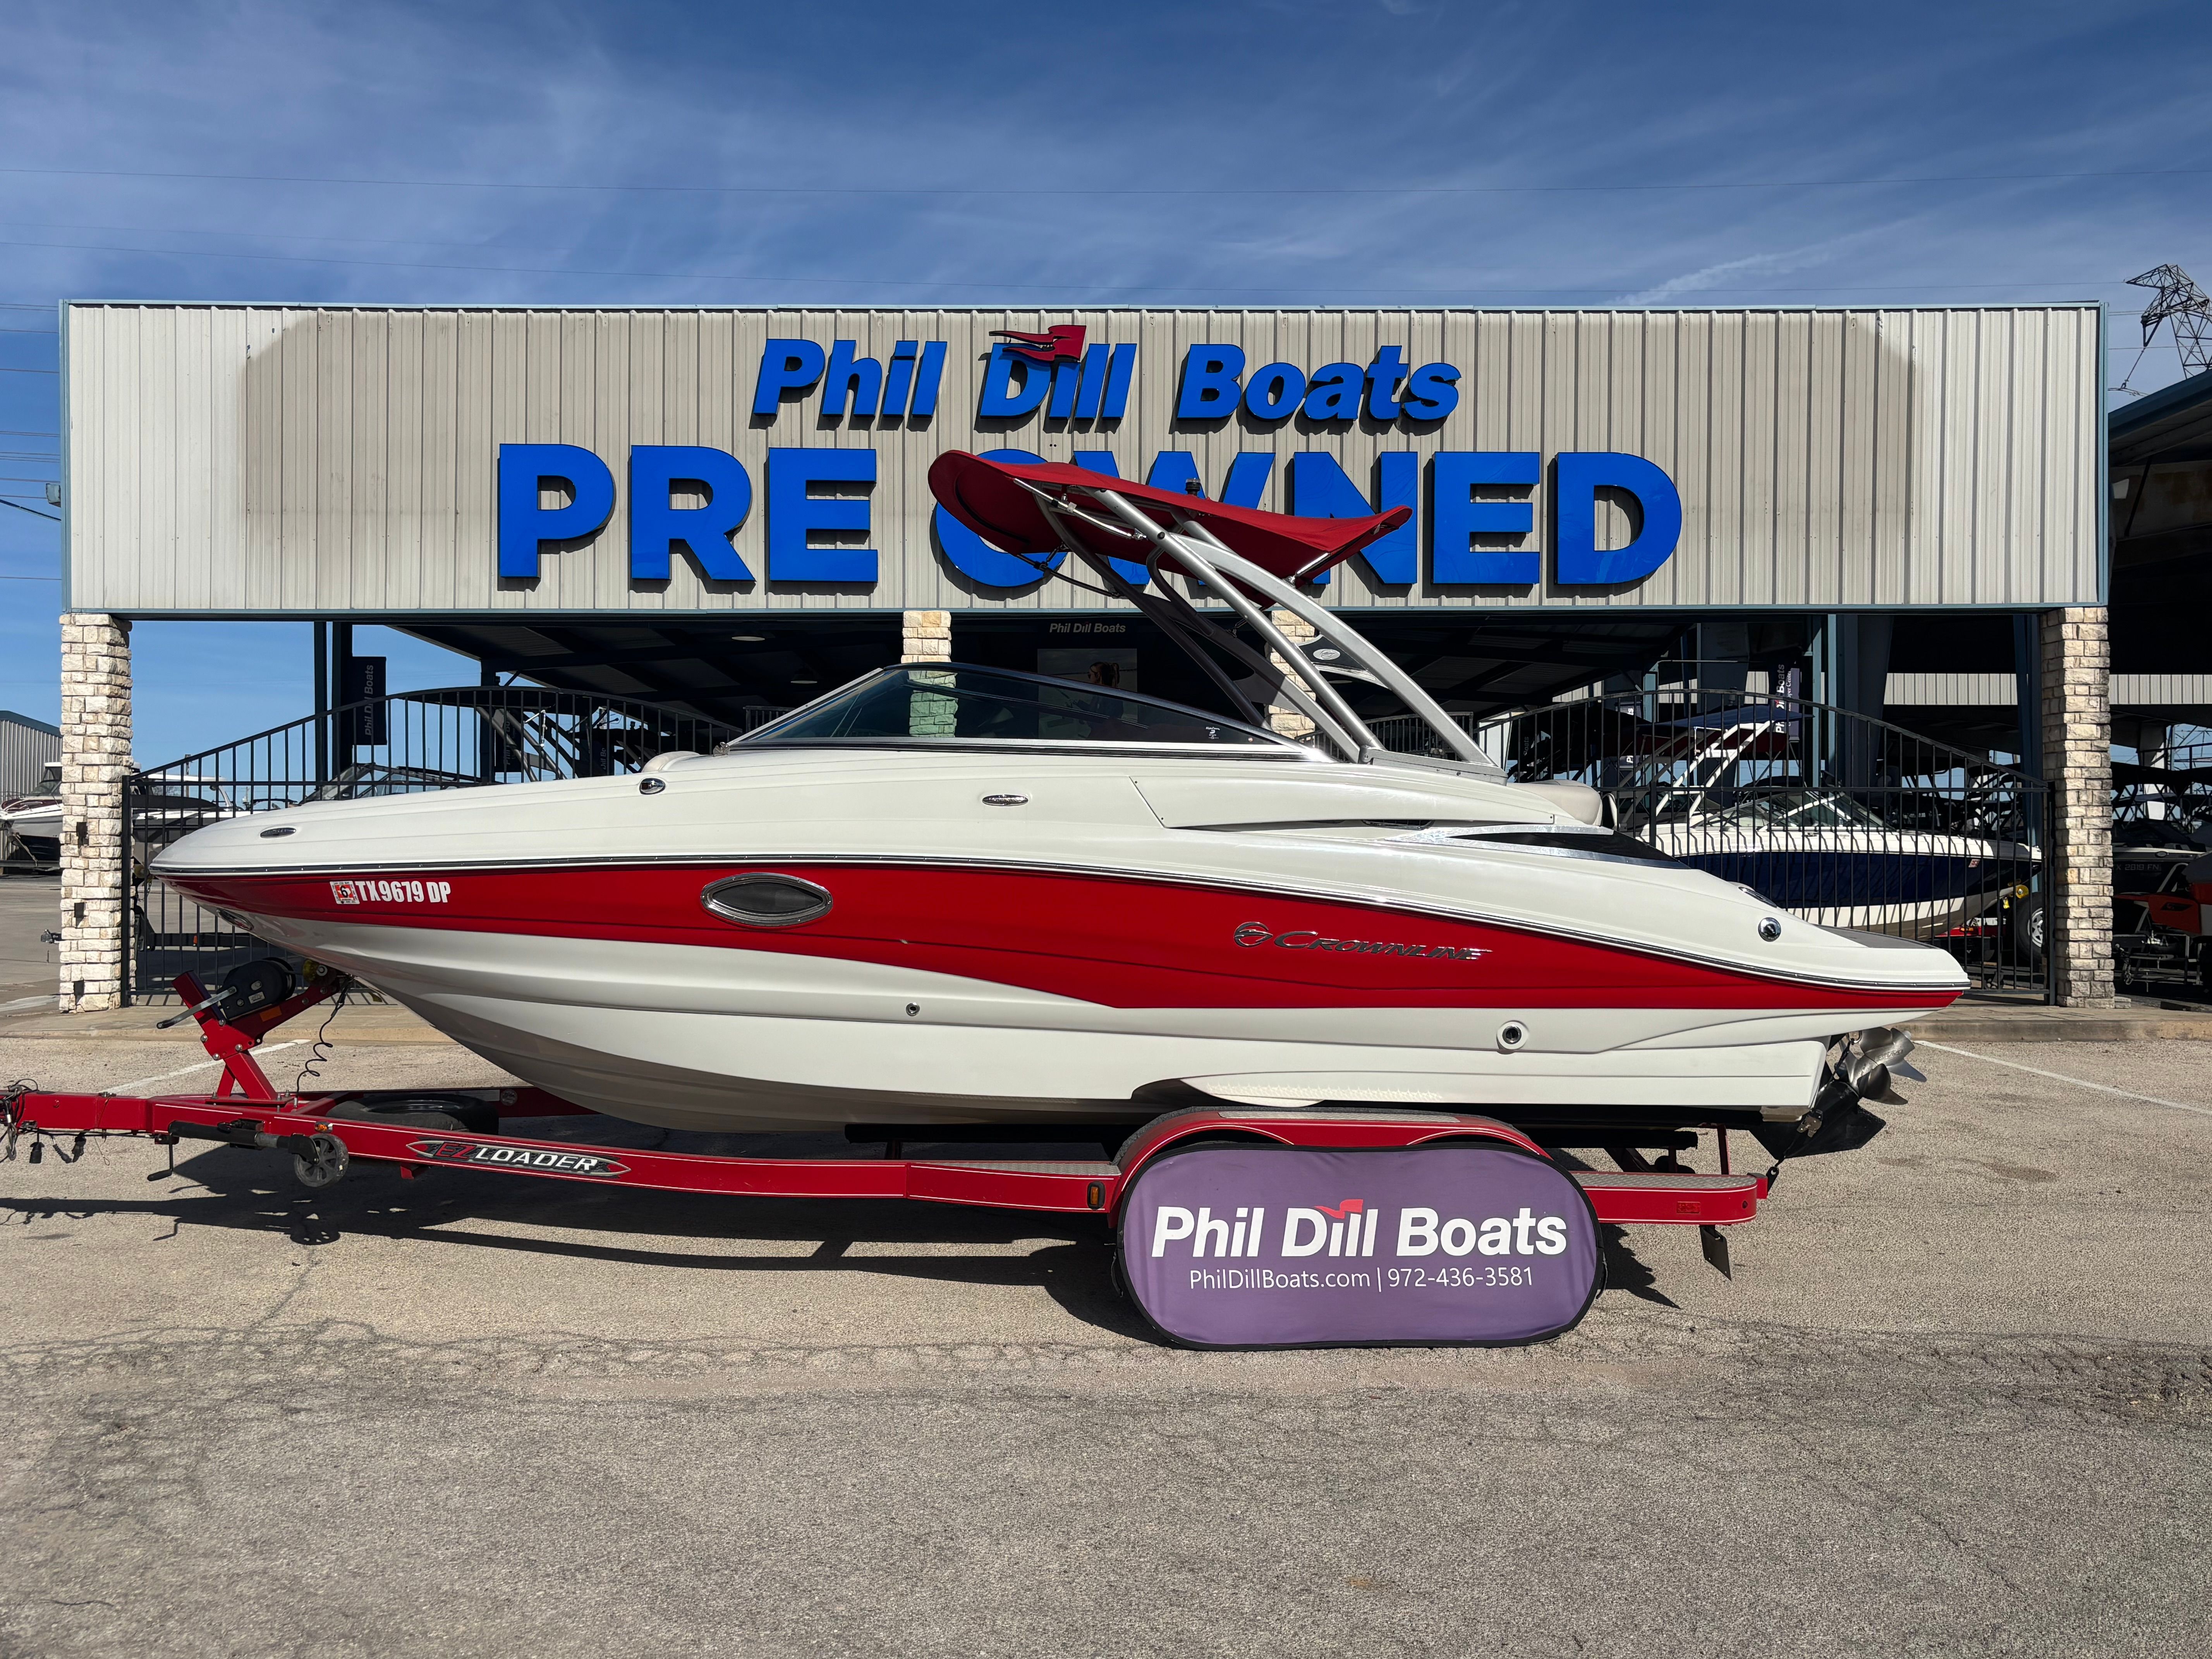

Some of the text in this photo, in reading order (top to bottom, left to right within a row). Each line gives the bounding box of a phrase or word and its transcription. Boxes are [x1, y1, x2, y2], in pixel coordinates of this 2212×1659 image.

[753, 339, 1461, 420] Phil Dill Boats
[499, 444, 878, 582] PRE
[1049, 623, 1126, 632] Phil Dill Boats
[364, 665, 373, 695] Boats
[1776, 664, 1785, 694] Boats
[364, 716, 373, 736] Phil
[426, 881, 451, 903] DP
[1151, 1207, 1567, 1257] Phil Dill Boats
[1190, 1266, 1532, 1289] PhilDillBoats.com 972-436-3581
